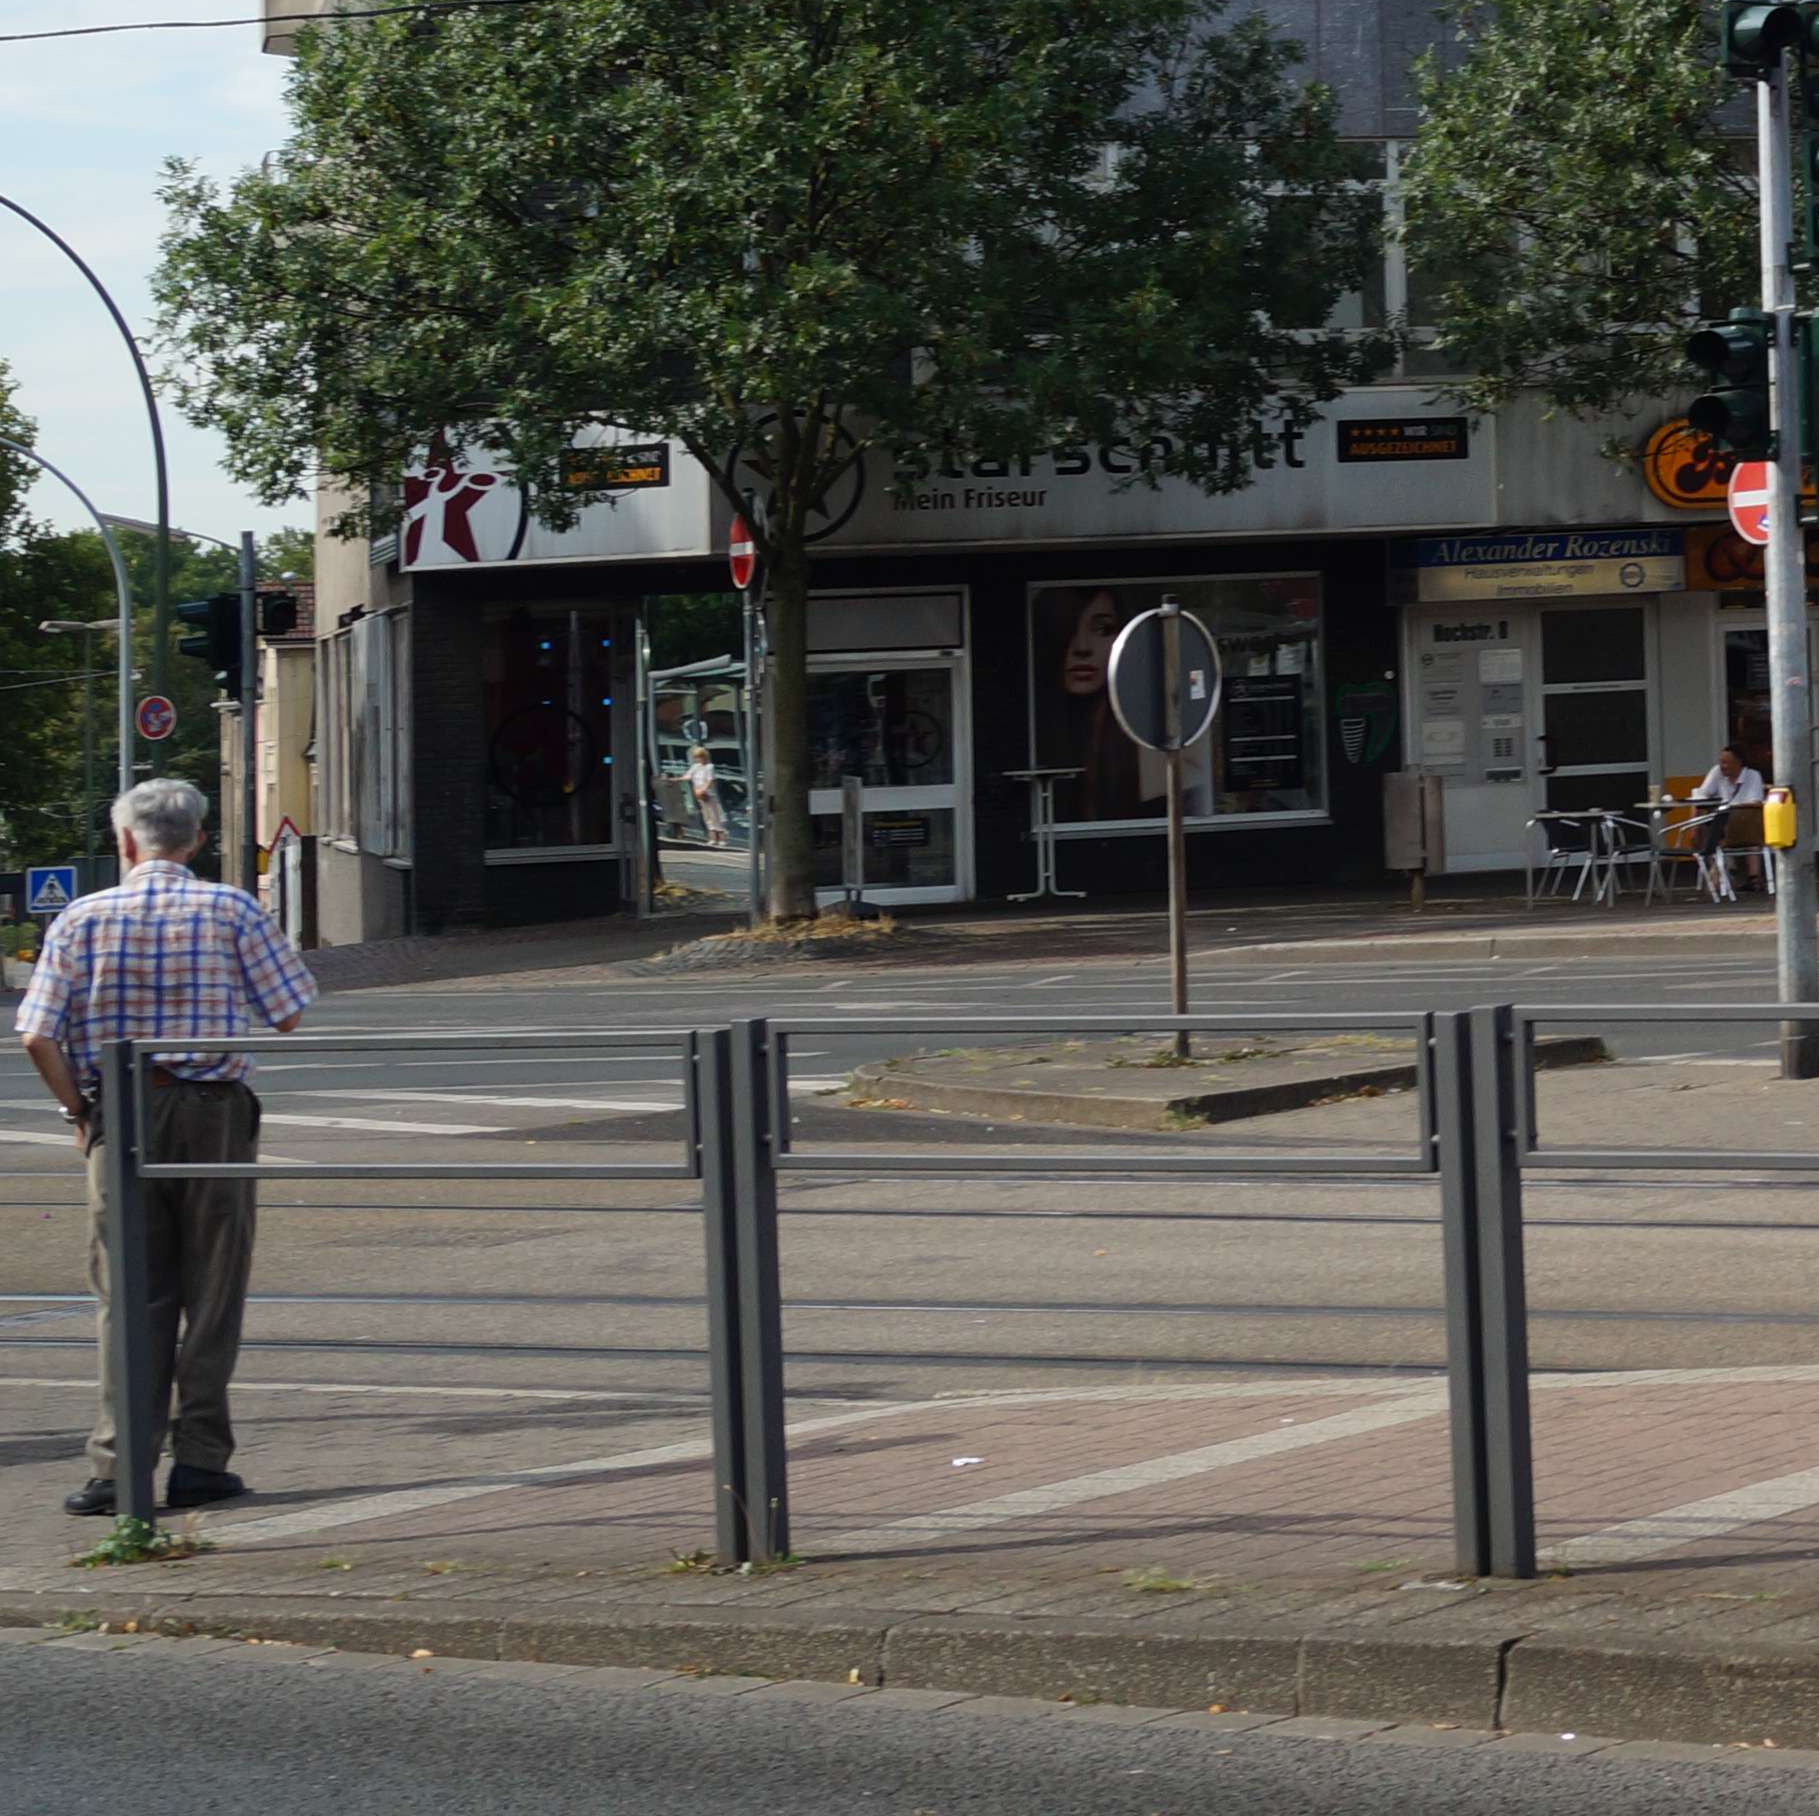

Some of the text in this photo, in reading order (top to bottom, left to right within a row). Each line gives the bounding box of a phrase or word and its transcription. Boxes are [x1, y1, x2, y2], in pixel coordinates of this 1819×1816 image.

[964, 487, 1048, 510] Friseur
[1433, 530, 1672, 563] Alexander Rozenski
[1463, 562, 1596, 580] Hausverwaltungen
[1496, 582, 1574, 596] Immobilien
